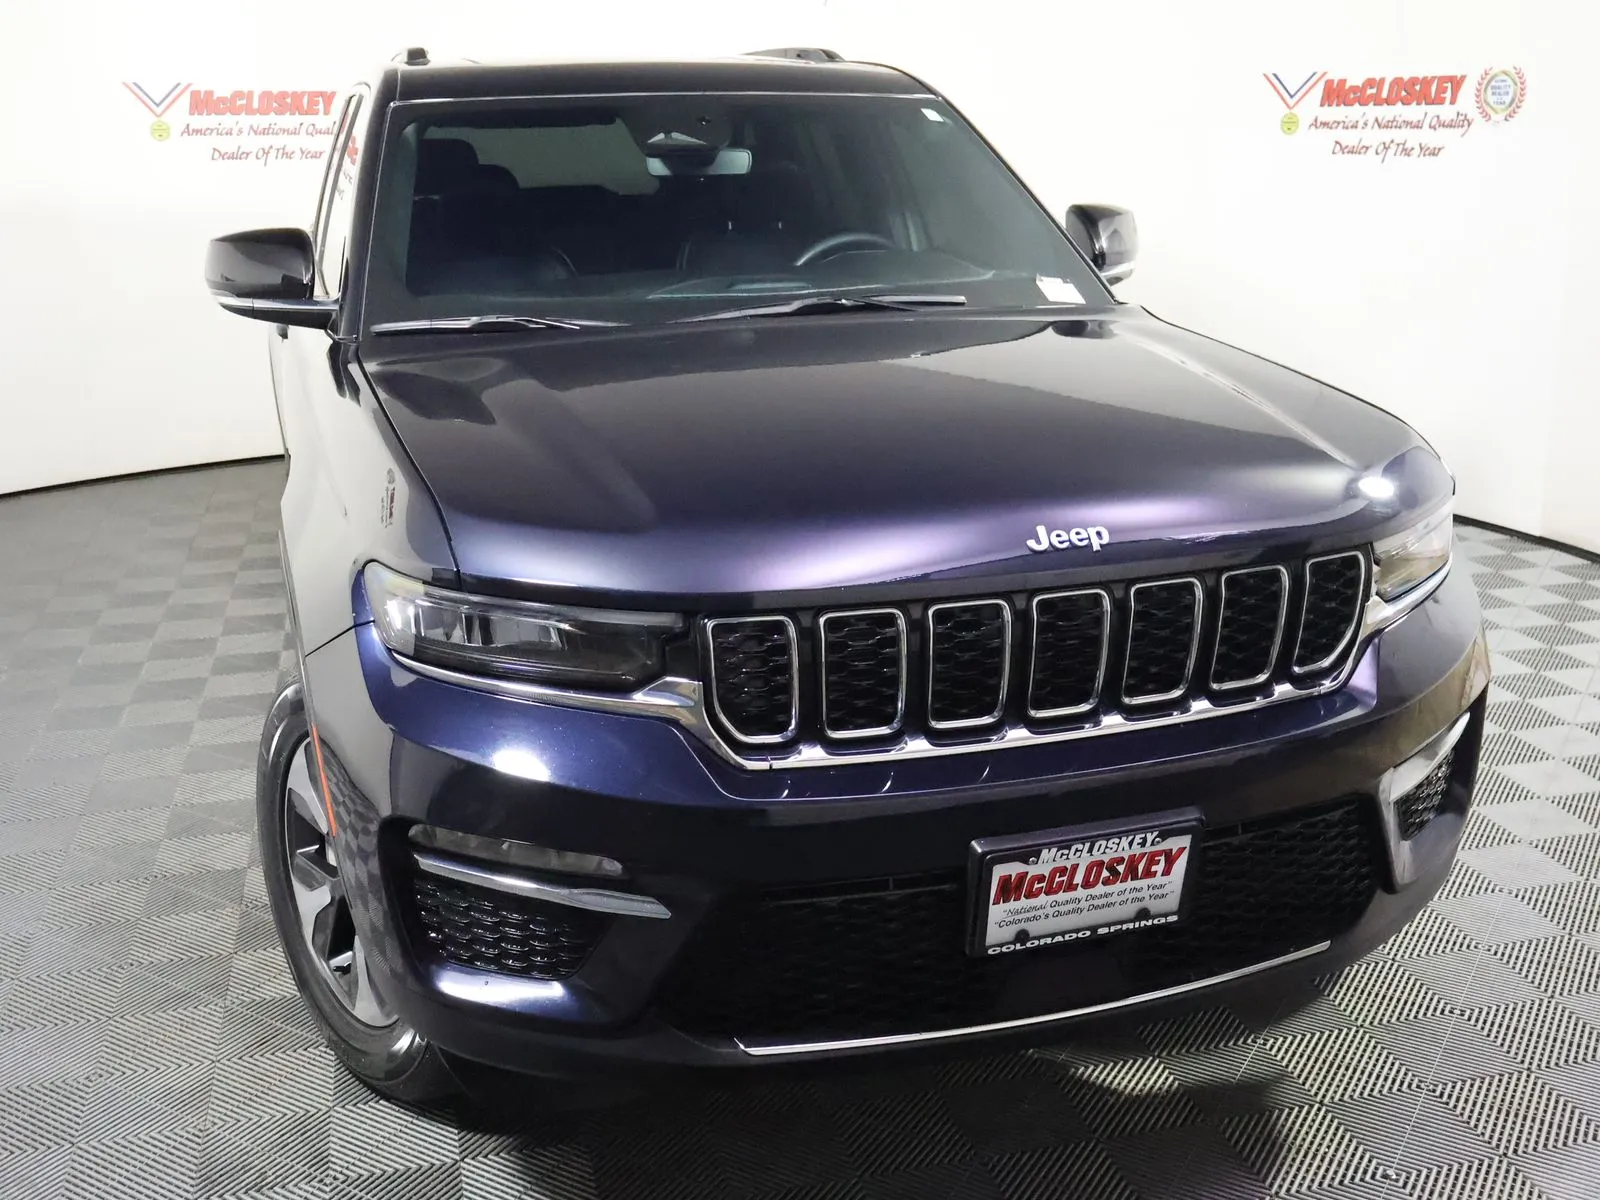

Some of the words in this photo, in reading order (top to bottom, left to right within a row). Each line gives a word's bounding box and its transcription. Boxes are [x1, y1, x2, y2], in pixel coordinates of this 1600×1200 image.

[188, 90, 337, 116] McCLOSKEY
[1319, 74, 1467, 107] McCLOSKEY
[180, 122, 244, 138] America's
[247, 121, 303, 137] National
[305, 120, 336, 137] Qual
[1308, 112, 1368, 131] America's
[1371, 112, 1427, 130] National
[1428, 111, 1475, 138] Quality
[211, 145, 252, 161] Dealer
[255, 145, 274, 167] Of
[274, 145, 296, 160] The
[299, 147, 326, 160] Year
[1331, 140, 1372, 156] Dealer
[1374, 139, 1394, 164] Of
[1393, 141, 1415, 157] The
[1418, 142, 1445, 158] Year
[1026, 525, 1110, 552] Jeep
[1037, 831, 1160, 865] McCLOSKEY
[992, 846, 1188, 906] McCLOSKEY
[1049, 896, 1083, 909] Quality
[1085, 890, 1115, 902] Dealer
[1117, 887, 1129, 898] of
[1129, 884, 1144, 895] the
[1052, 906, 1084, 919] Quality
[1087, 900, 1117, 913] Dealer
[1119, 897, 1131, 907] of
[1130, 894, 1146, 904] the
[987, 929, 1091, 955] COLORADO
[1096, 914, 1179, 936] SPRINGS
